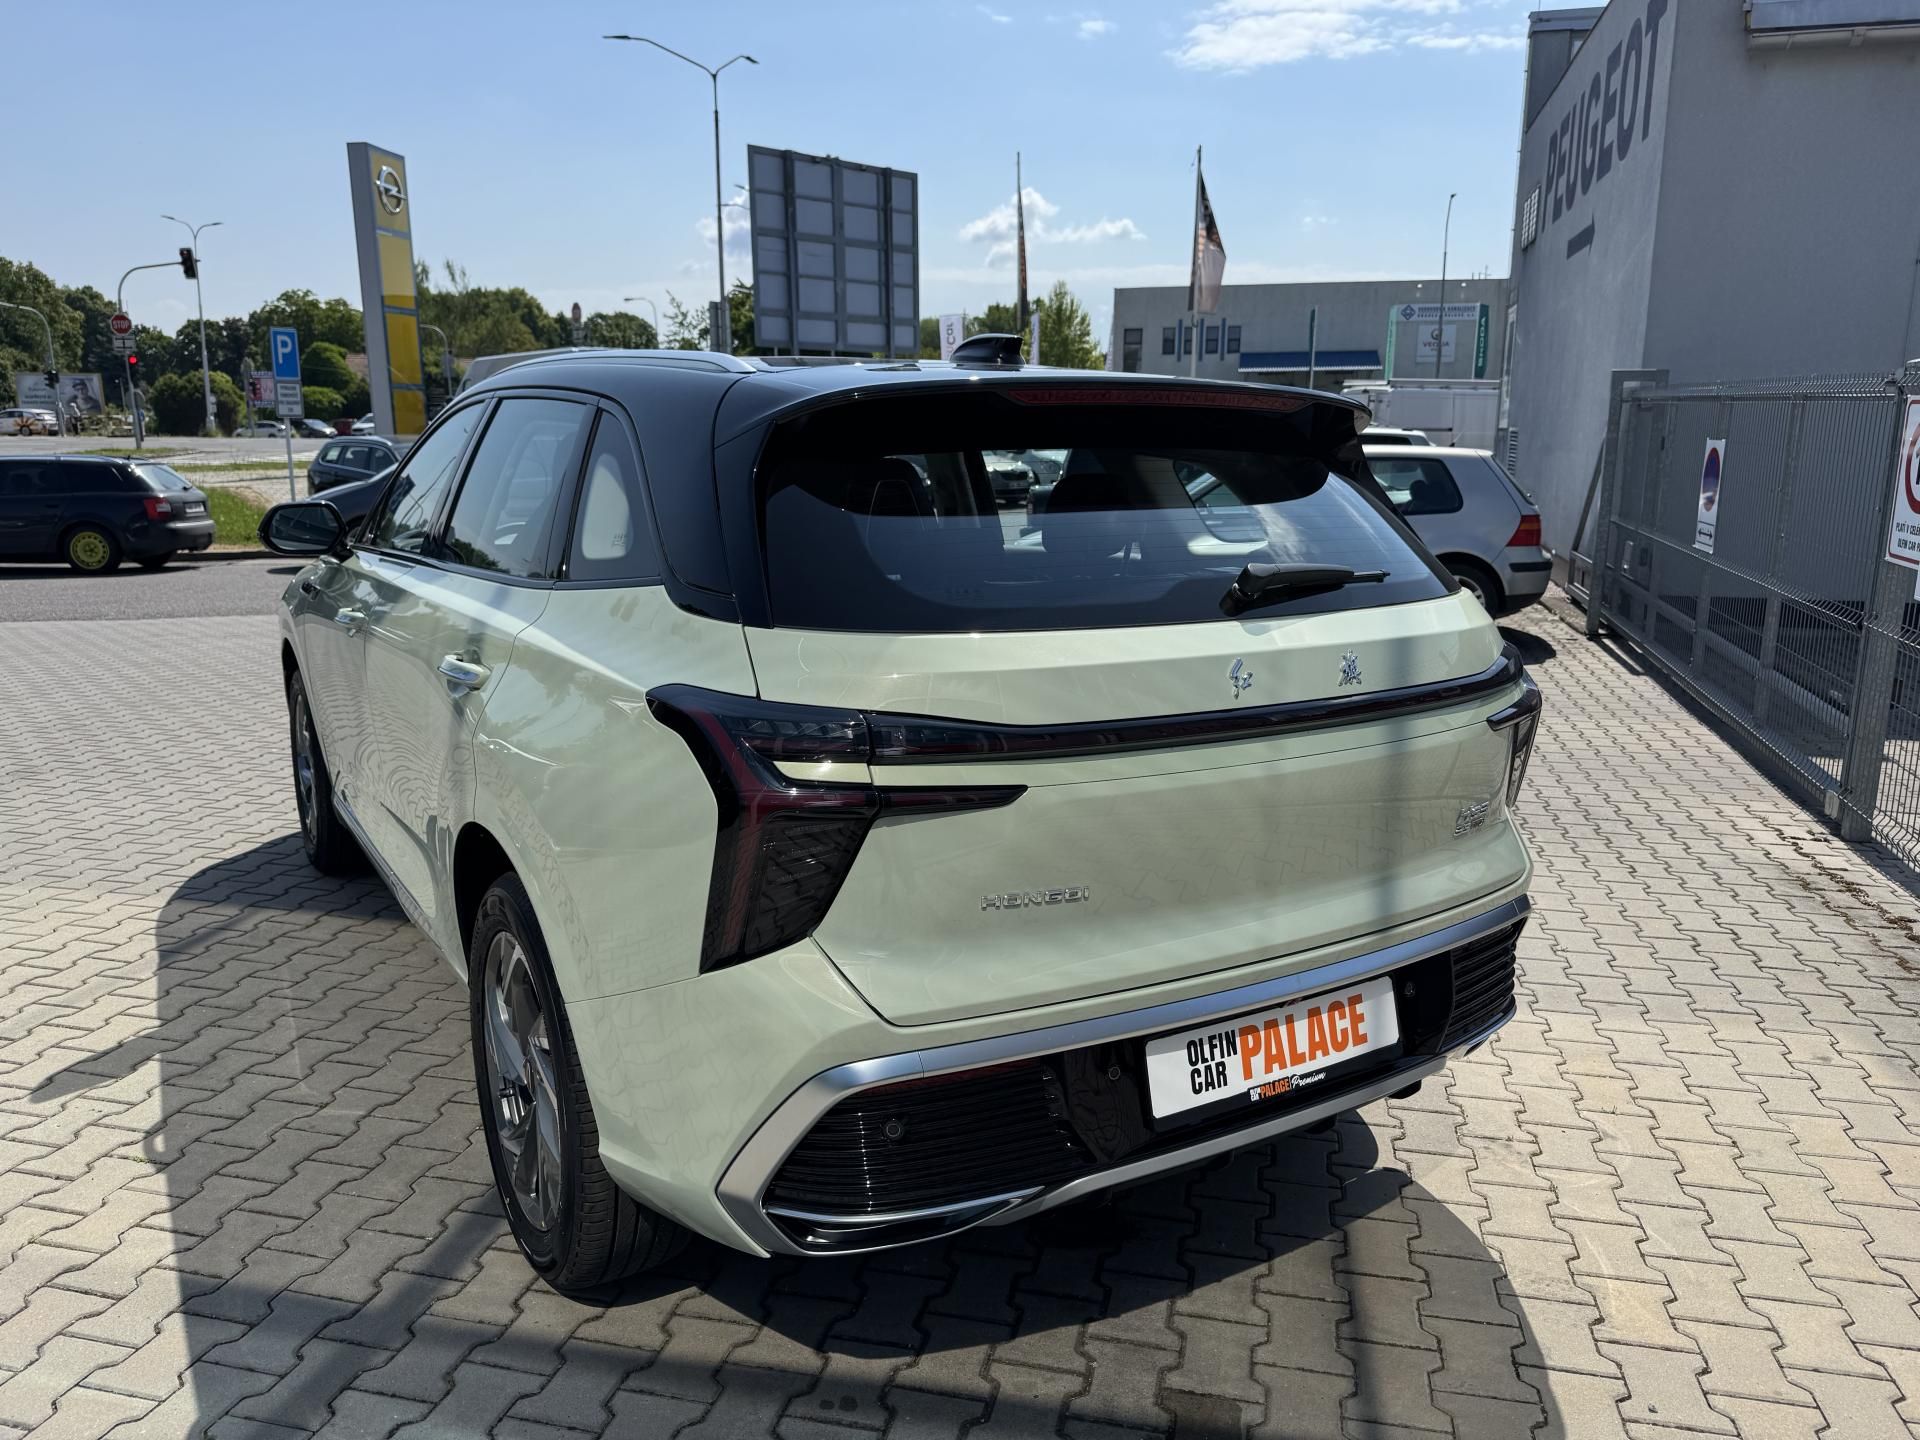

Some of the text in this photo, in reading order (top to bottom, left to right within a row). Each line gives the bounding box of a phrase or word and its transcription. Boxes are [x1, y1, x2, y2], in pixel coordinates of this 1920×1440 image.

[1541, 0, 1668, 233] PEUGEOT
[112, 320, 130, 329] STOP
[277, 335, 292, 365] P
[1908, 540, 1916, 551] CAR
[1186, 1029, 1238, 1067] OLFIN
[1238, 993, 1368, 1081] PALACE
[1190, 1060, 1228, 1095] CAR
[1260, 1071, 1327, 1099] PALACE Premium
